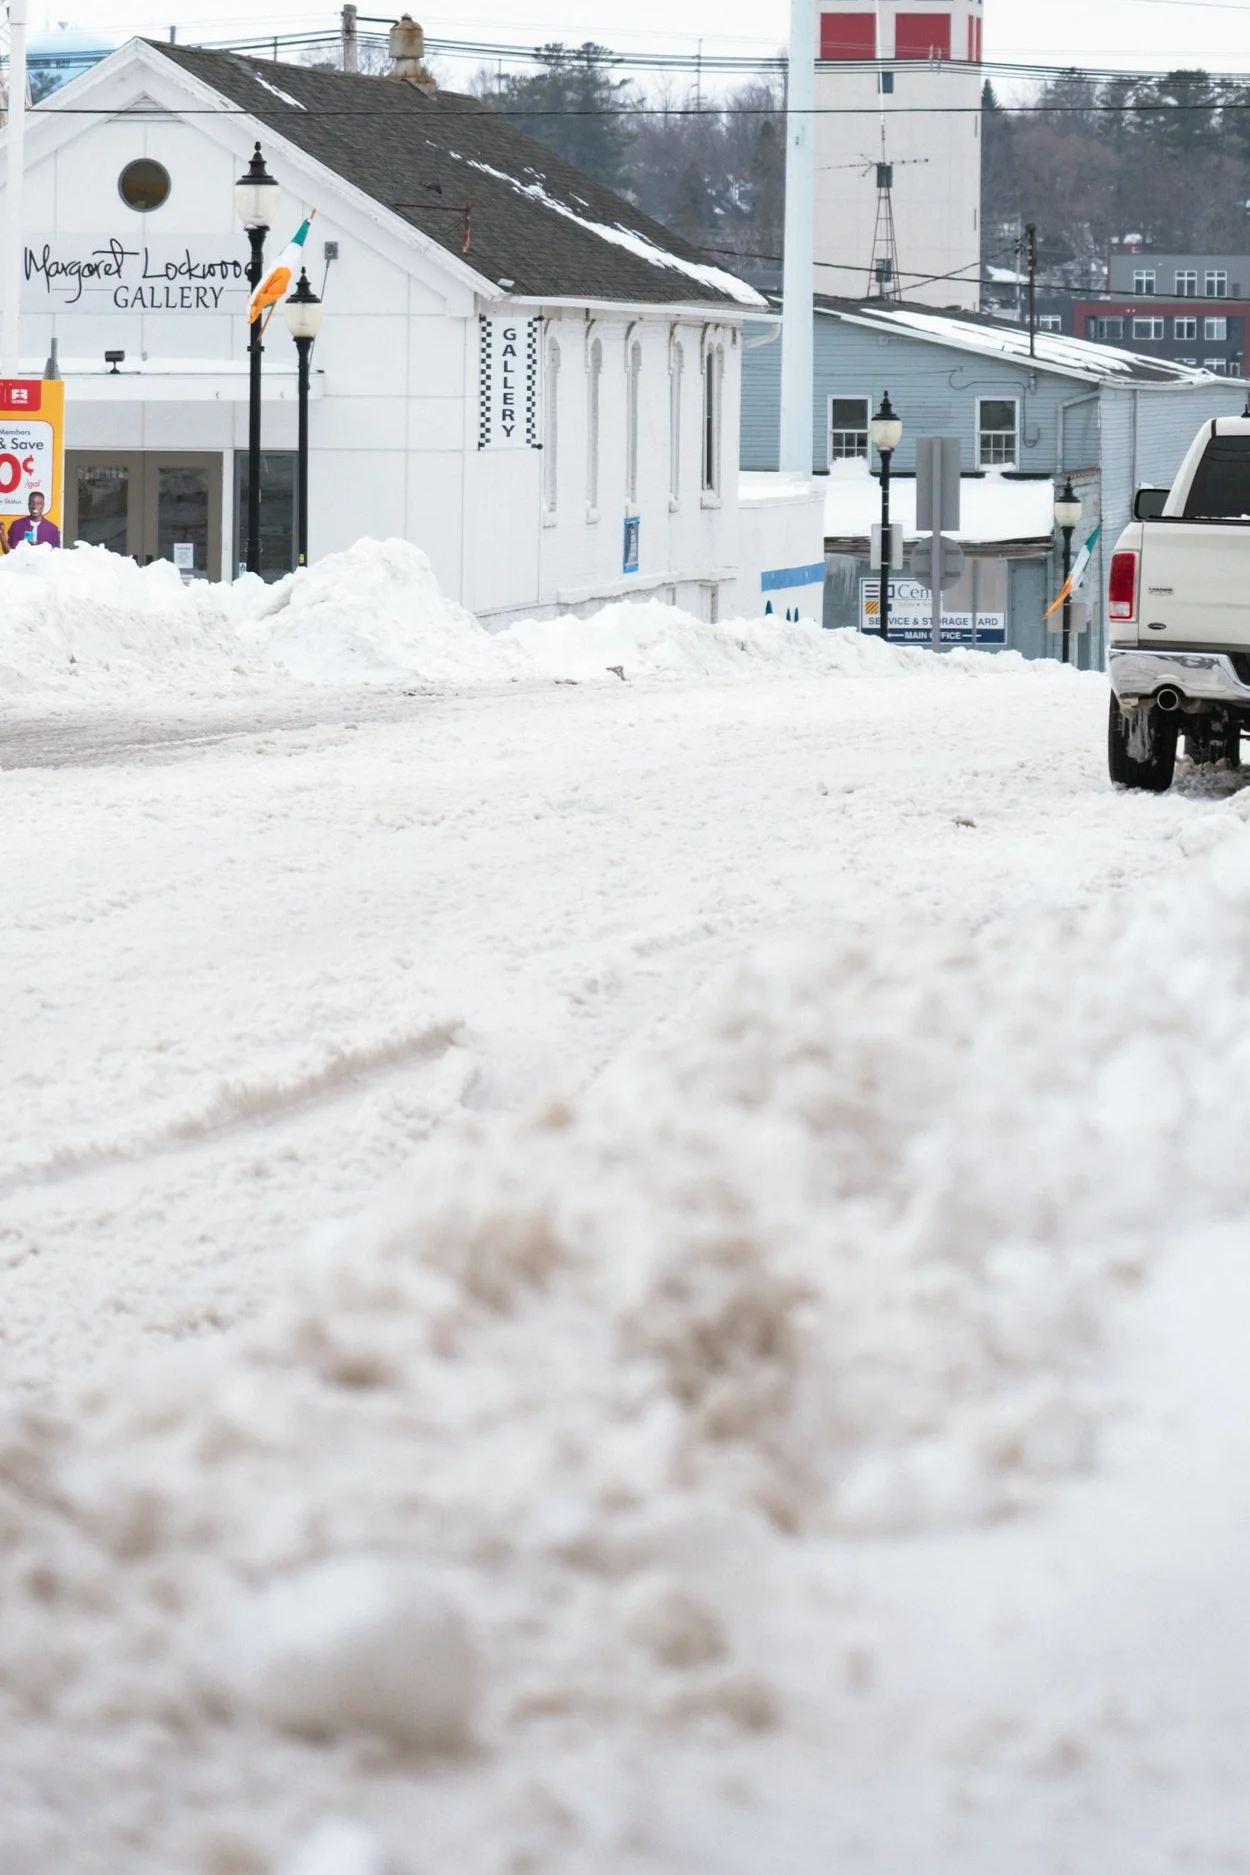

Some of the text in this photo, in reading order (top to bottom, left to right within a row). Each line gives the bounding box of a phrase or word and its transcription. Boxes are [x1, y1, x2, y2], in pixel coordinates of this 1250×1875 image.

[24, 238, 252, 303] Margaret Lockwoo
[113, 285, 225, 309] GALLERY
[501, 328, 517, 438] GALLERY
[11, 437, 44, 450] Save
[868, 617, 999, 626] SEVICE & STRAGE ARD
[904, 631, 928, 640] MAIN
